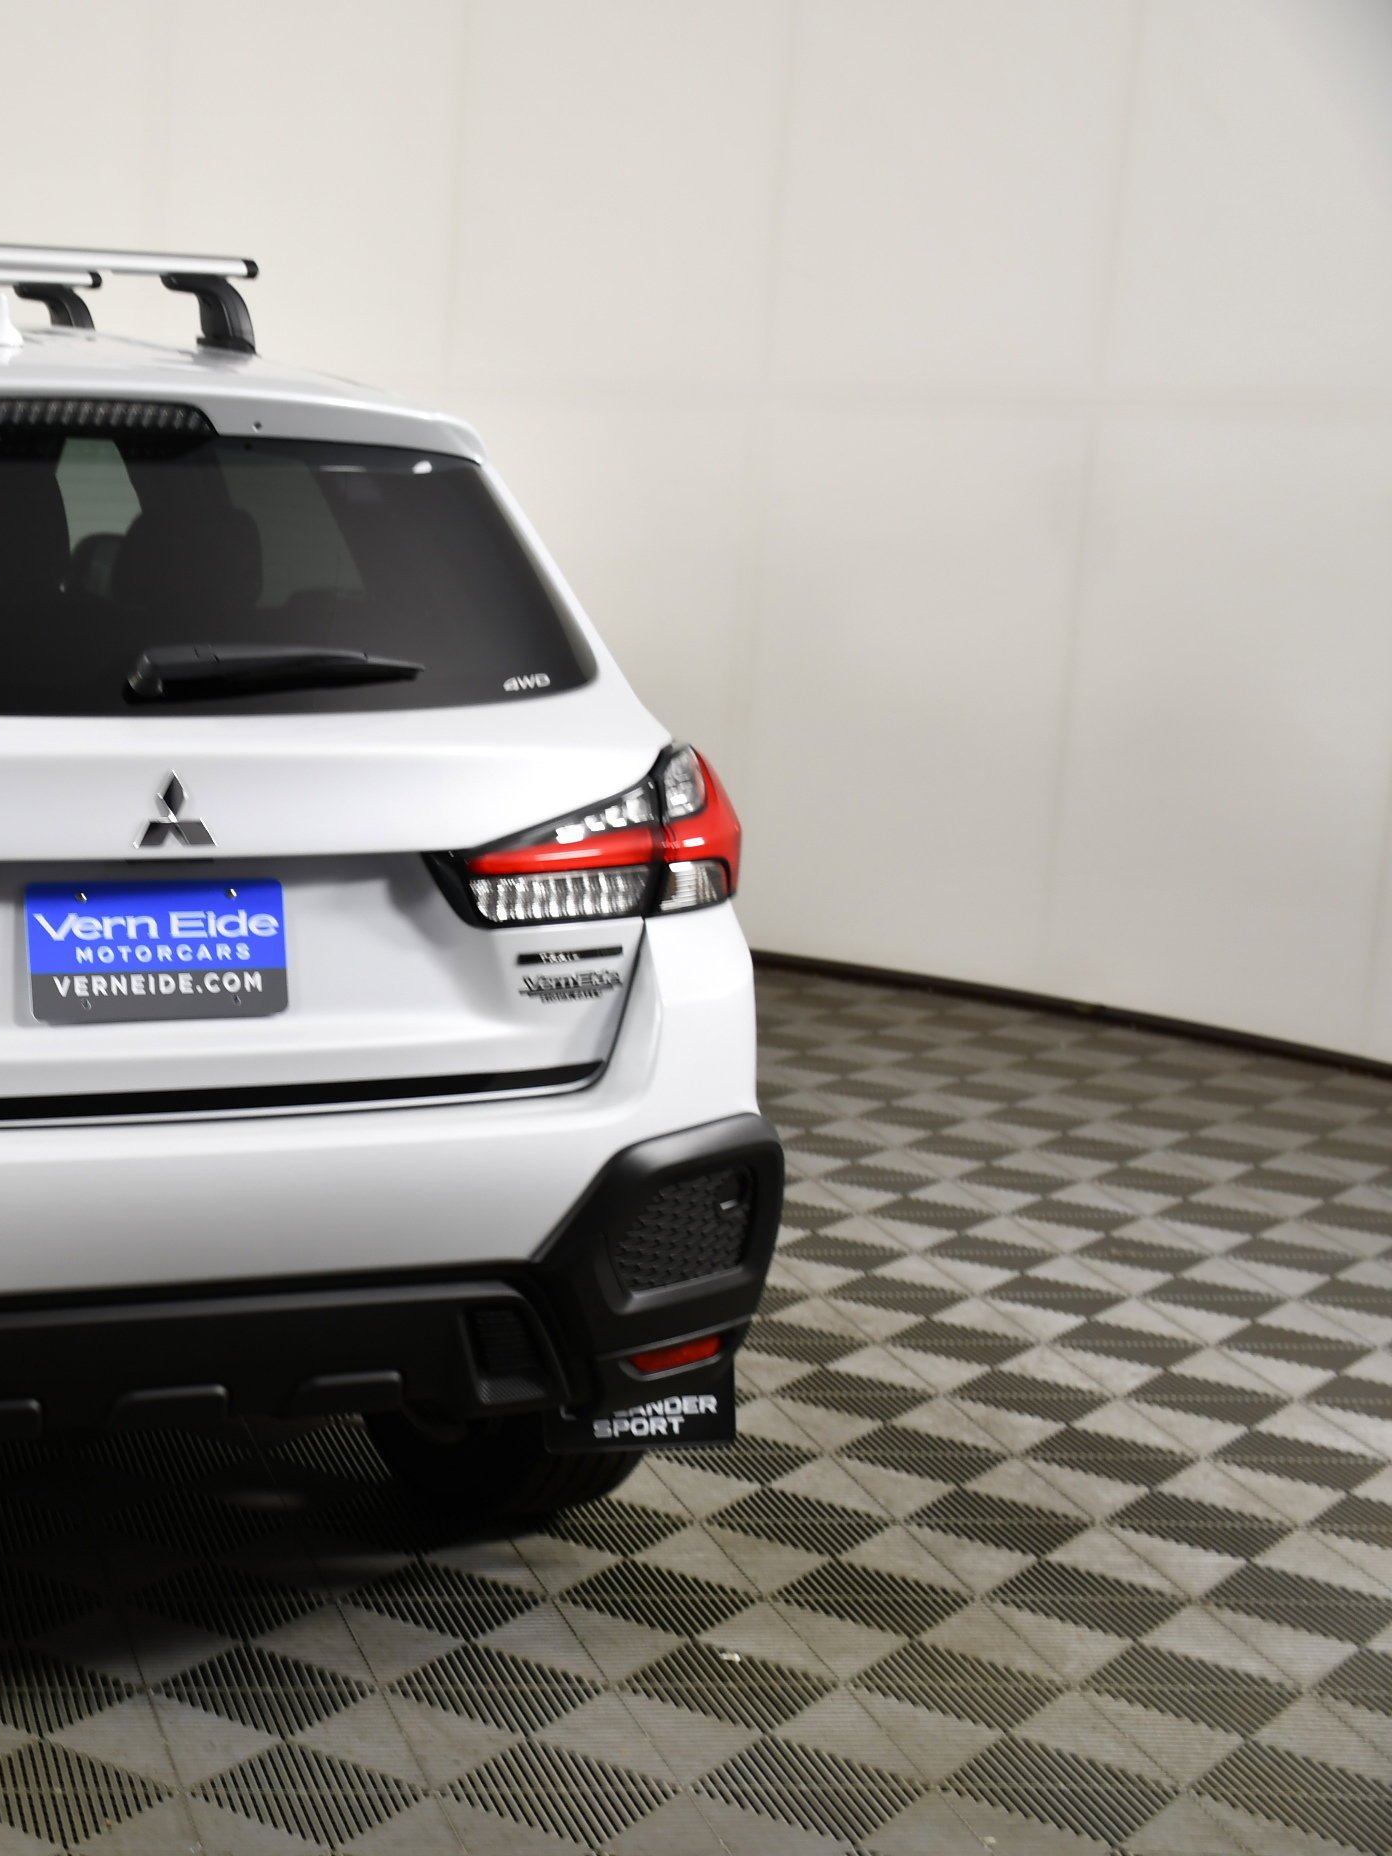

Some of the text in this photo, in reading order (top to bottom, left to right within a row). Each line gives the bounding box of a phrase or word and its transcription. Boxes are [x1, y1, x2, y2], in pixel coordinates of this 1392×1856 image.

[503, 673, 550, 691] 4WD
[33, 908, 280, 942] Vern Eide
[75, 943, 251, 964] MOTORCARS
[52, 970, 263, 998] VERNEIDE.COM
[614, 1394, 718, 1418] ANDER
[592, 1415, 685, 1439] SPORT
